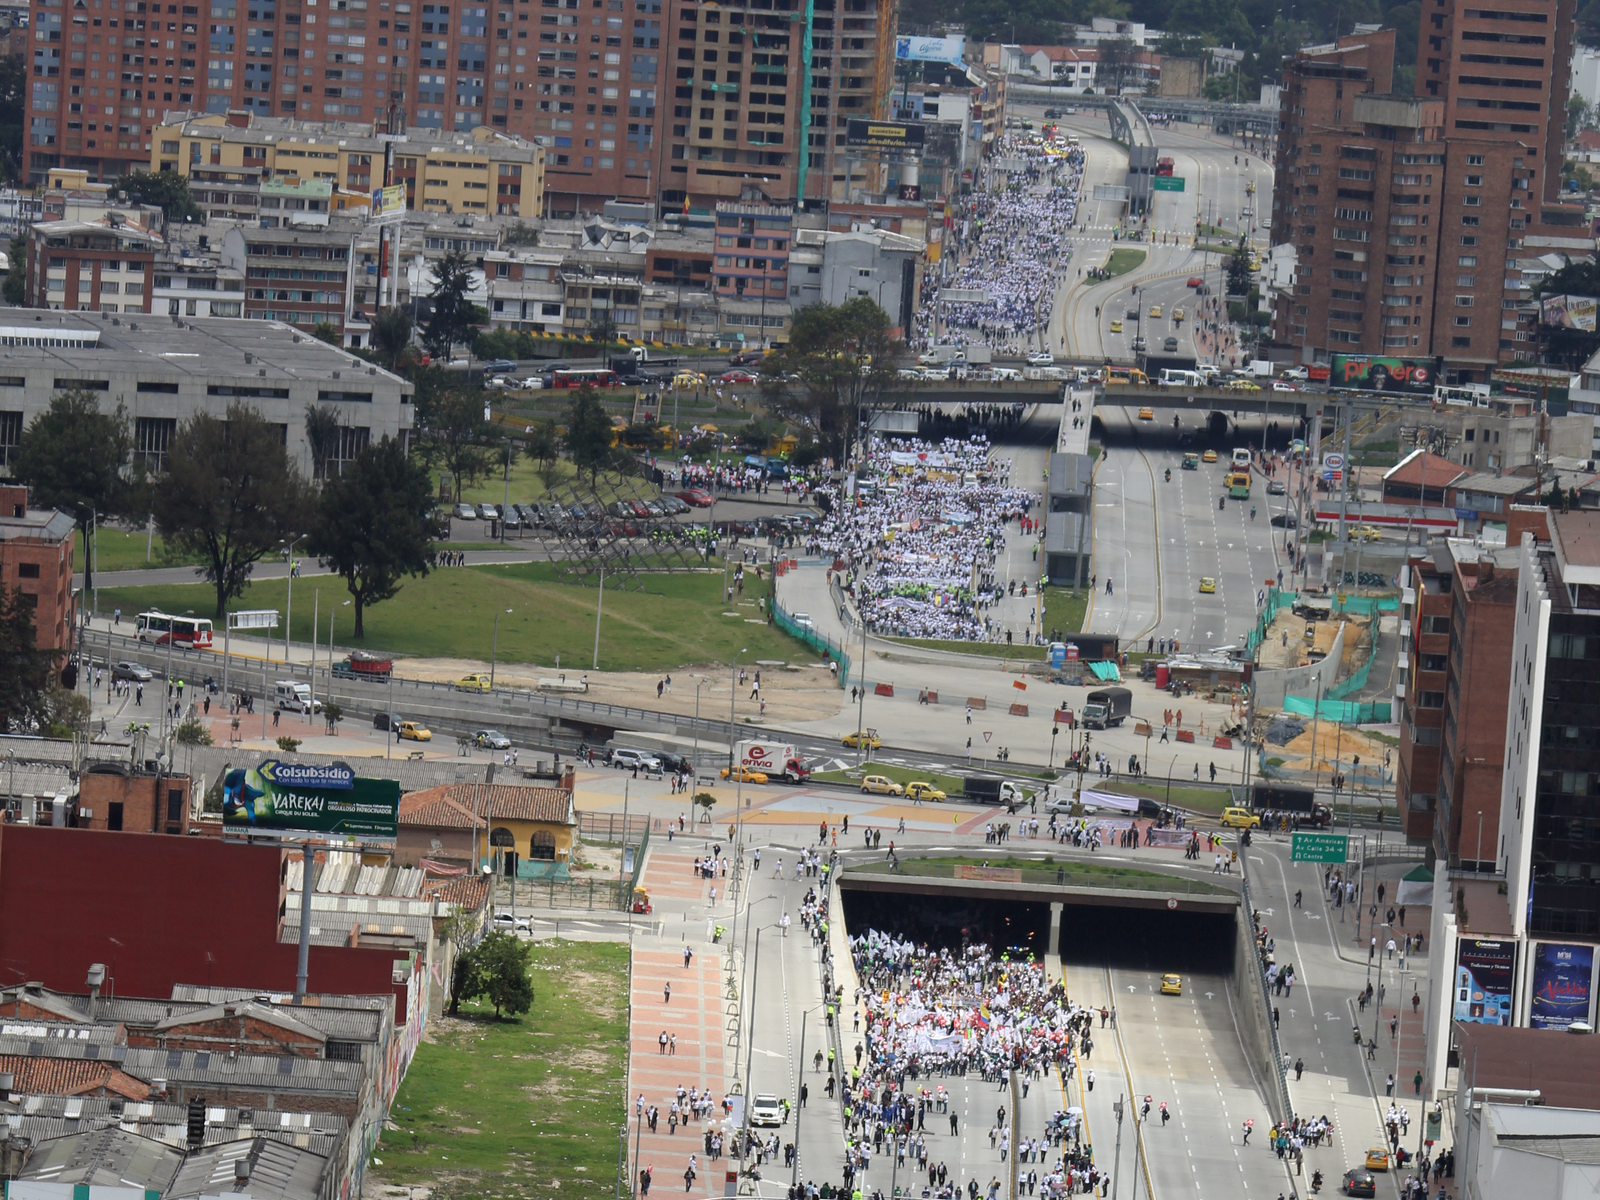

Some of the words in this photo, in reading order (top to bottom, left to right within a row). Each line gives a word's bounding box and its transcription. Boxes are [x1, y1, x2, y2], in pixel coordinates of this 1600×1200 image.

[275, 766, 350, 779] Colsubsidio
[271, 791, 325, 811] VAREKAI
[275, 809, 294, 817] CIRQUE
[356, 807, 392, 815] PATROCINADOR
[1536, 980, 1587, 1000] Aladdin
